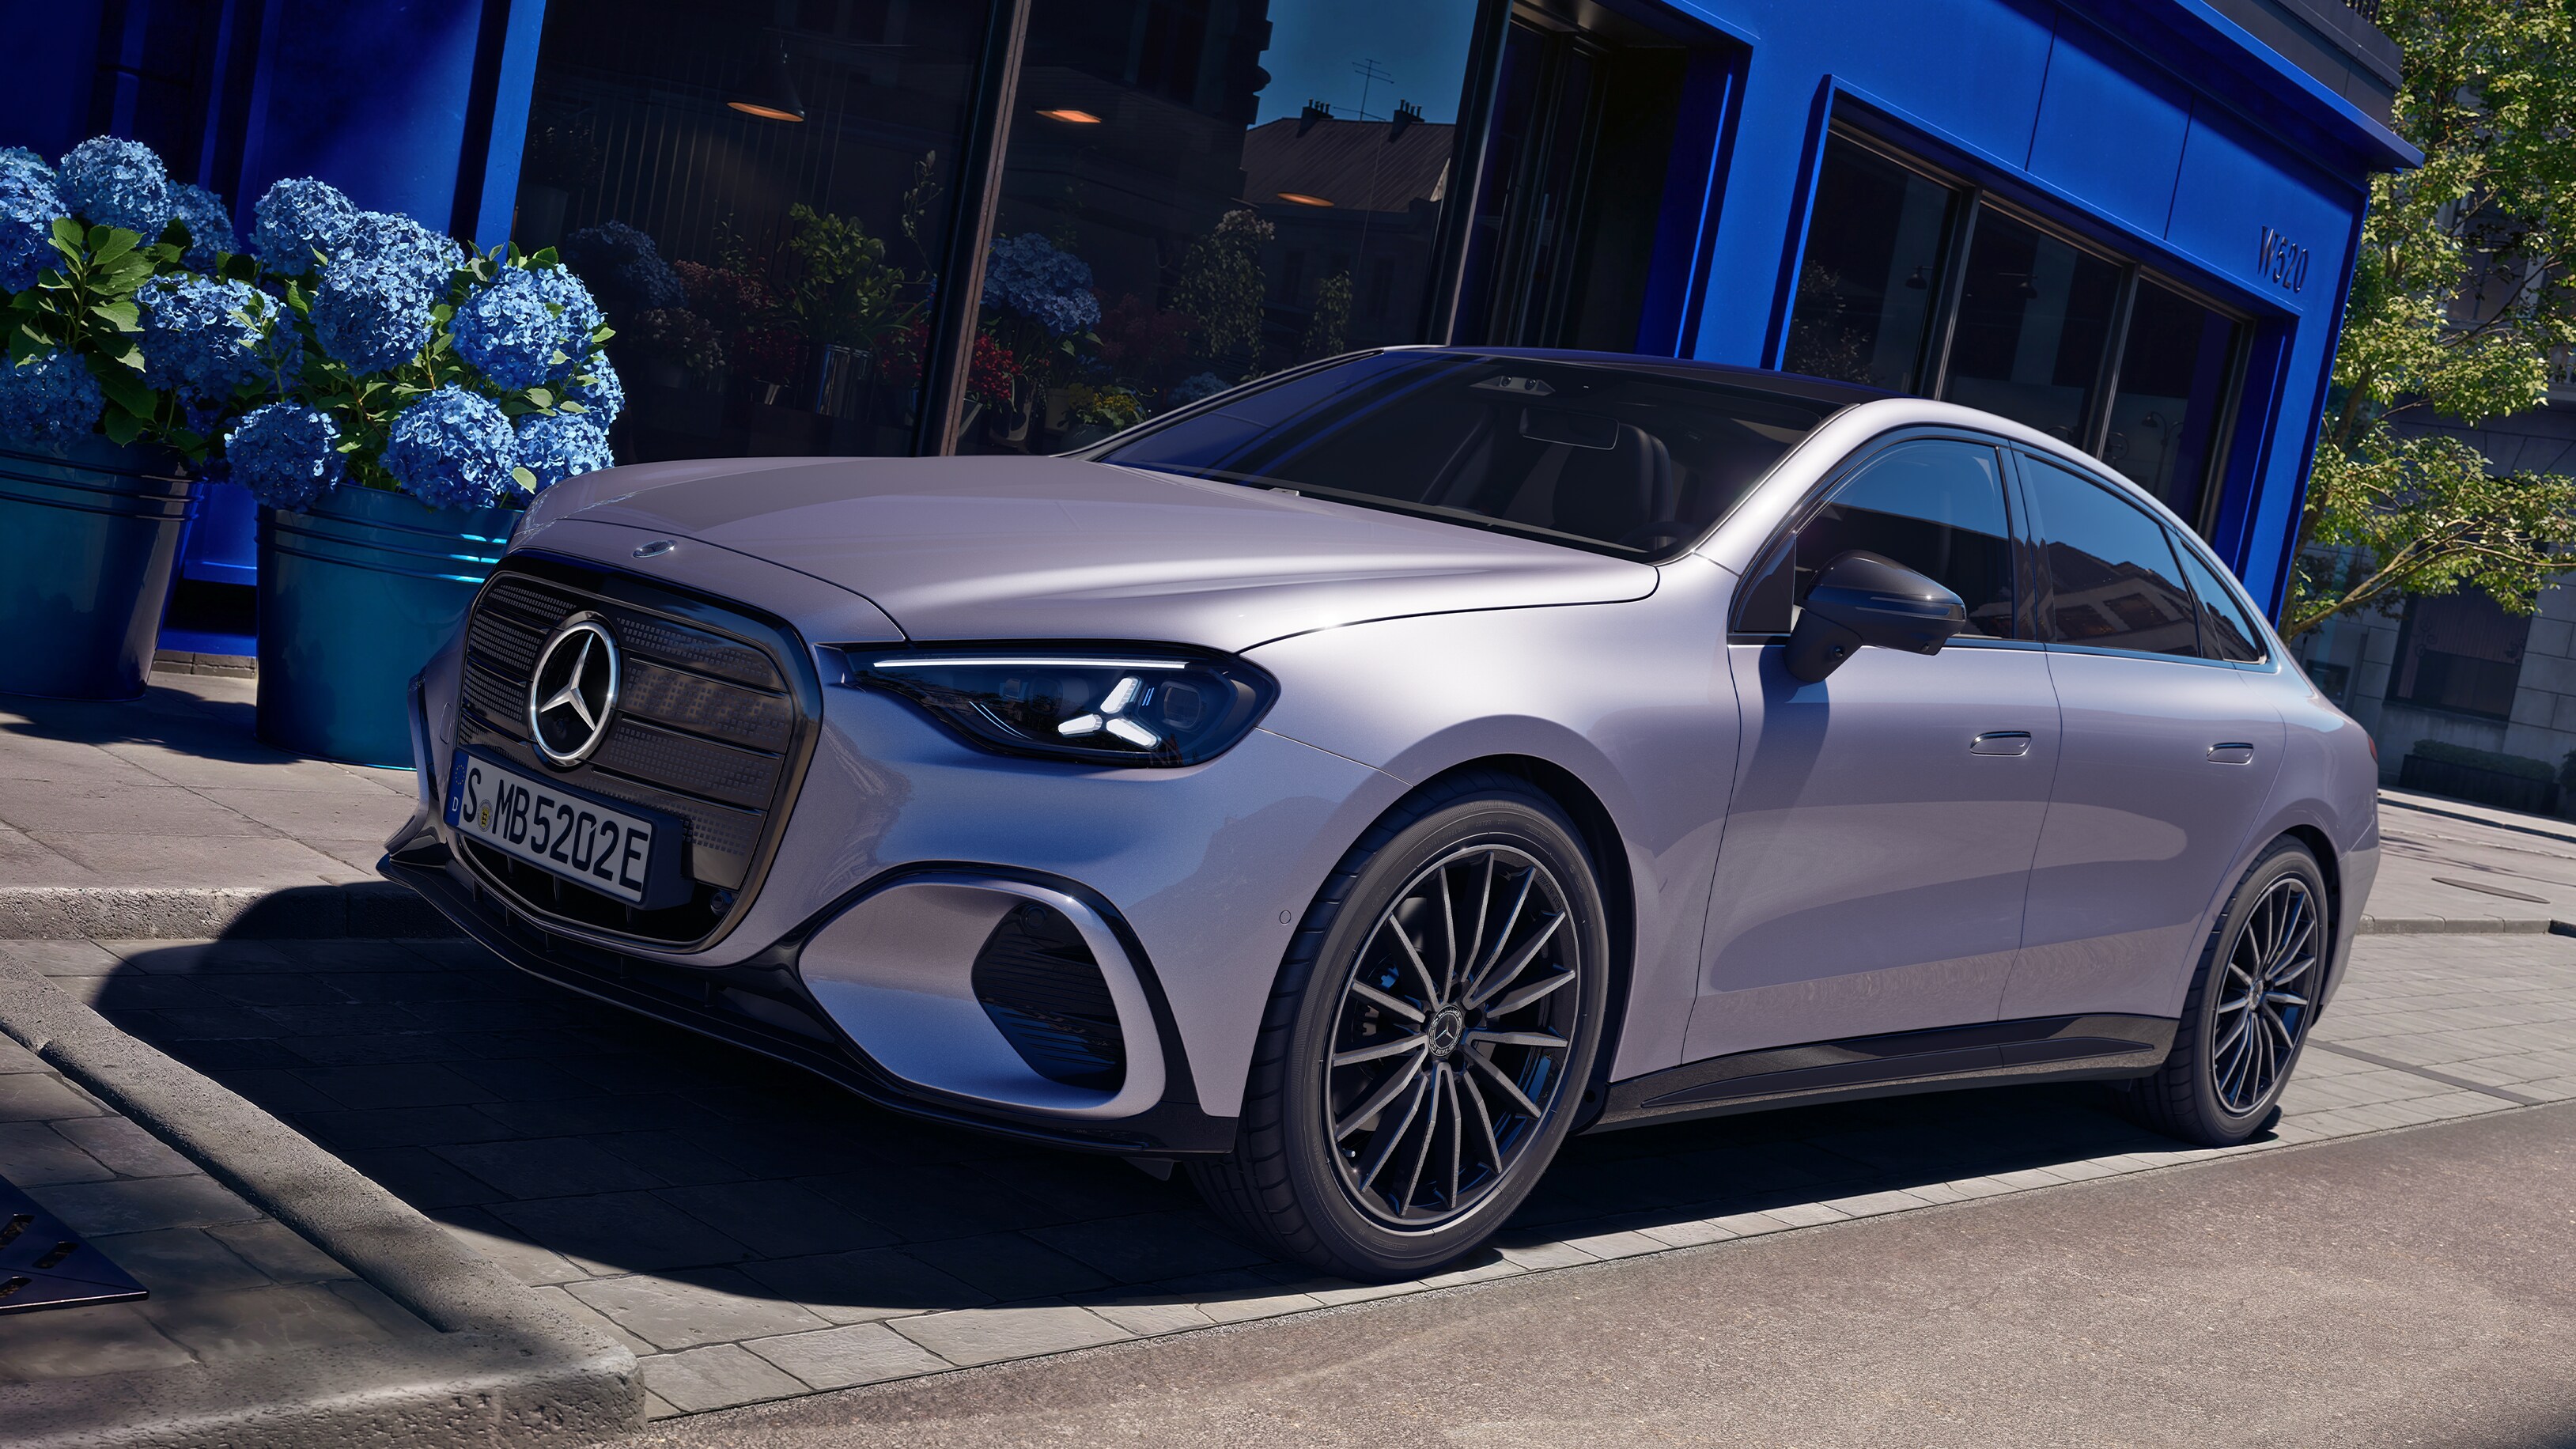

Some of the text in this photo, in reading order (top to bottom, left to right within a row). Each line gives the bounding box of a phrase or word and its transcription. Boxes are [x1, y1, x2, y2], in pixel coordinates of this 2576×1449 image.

[2257, 225, 2309, 293] W520
[451, 796, 460, 812] D
[463, 767, 482, 823] S
